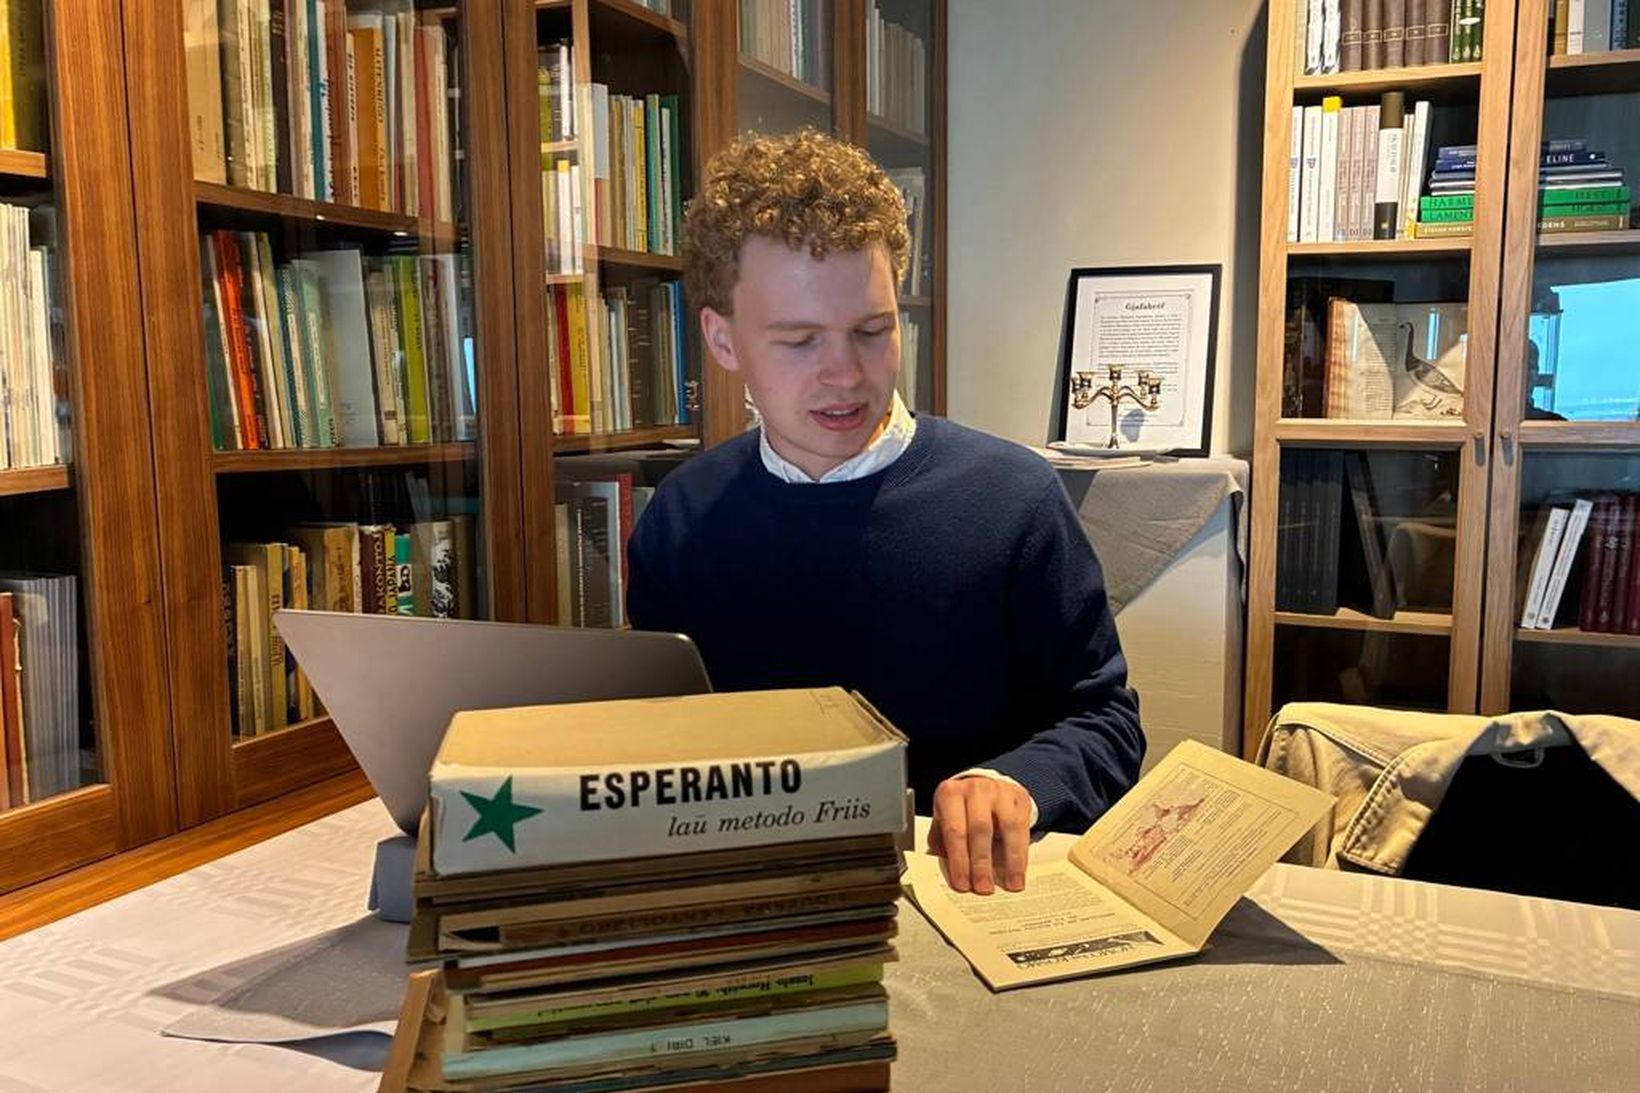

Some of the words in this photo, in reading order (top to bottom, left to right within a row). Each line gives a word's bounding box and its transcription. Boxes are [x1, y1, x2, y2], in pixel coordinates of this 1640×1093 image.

[579, 758, 802, 811] ESPERANTO
[718, 805, 805, 833] metodo
[813, 798, 871, 823] Friis
